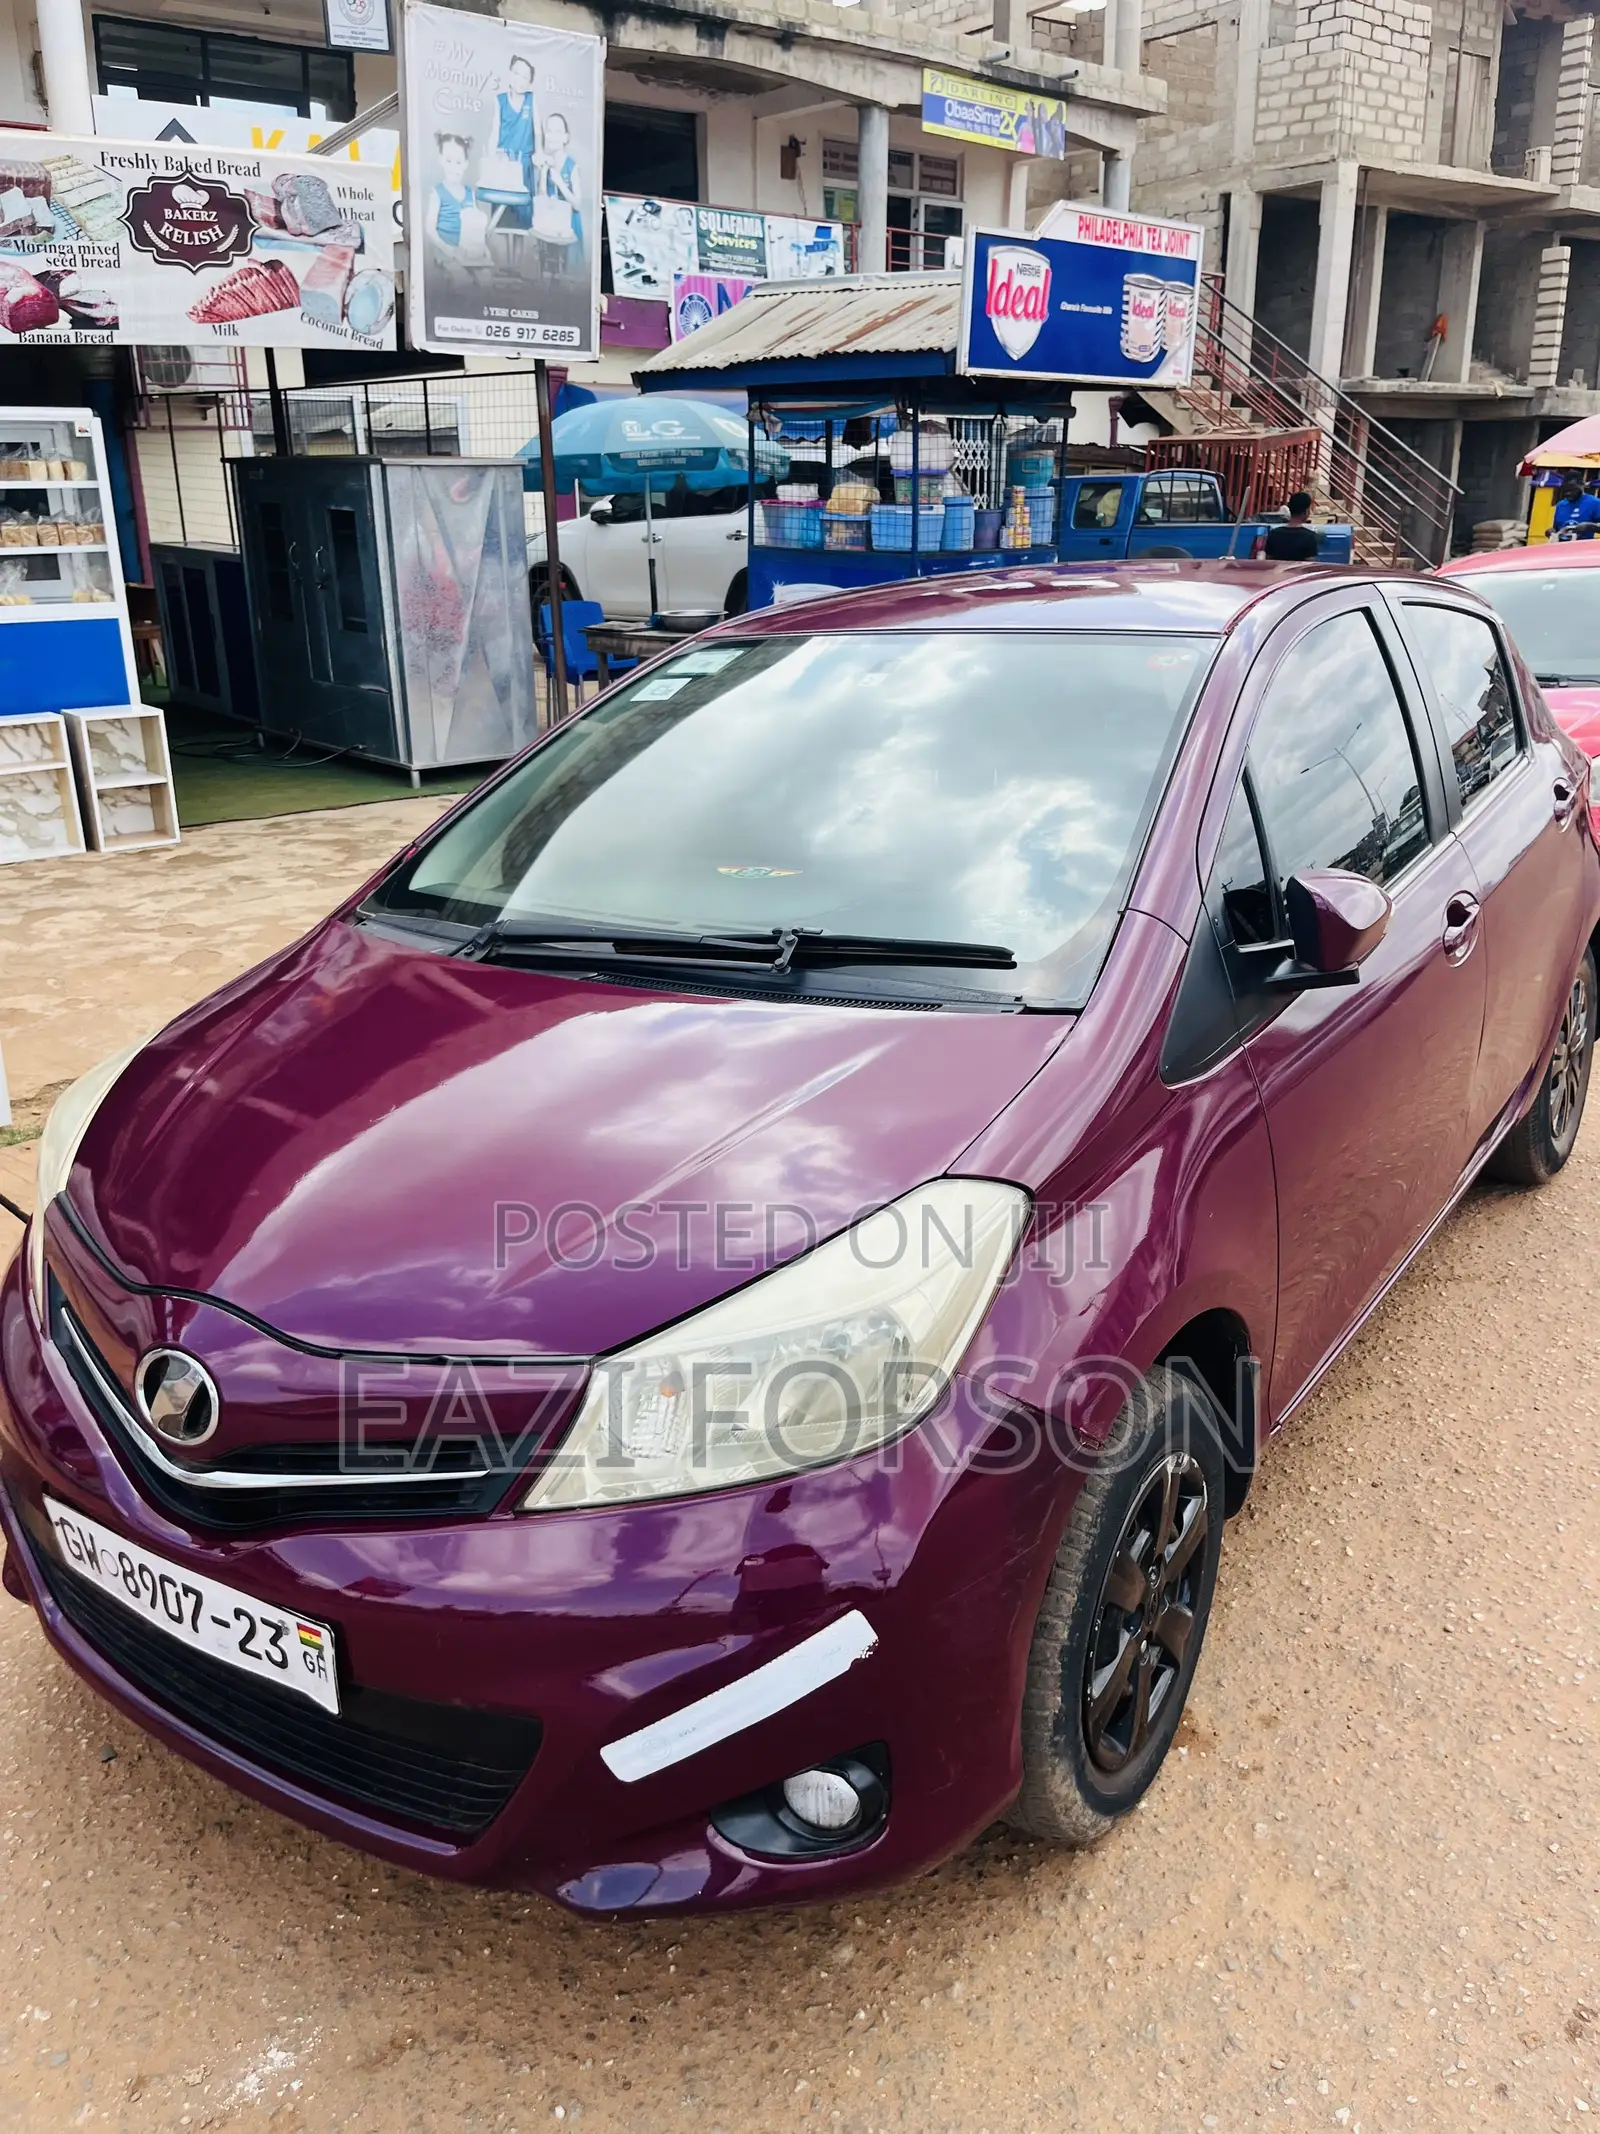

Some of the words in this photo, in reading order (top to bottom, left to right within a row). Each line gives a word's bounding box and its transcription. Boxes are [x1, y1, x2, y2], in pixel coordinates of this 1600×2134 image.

[433, 87, 484, 115] Cake
[100, 150, 160, 175] Freshly
[164, 156, 213, 175] Baked
[217, 159, 262, 178] Bread
[336, 186, 375, 201] Whole
[163, 207, 219, 223] BAKERZ
[338, 207, 376, 222] Wheat
[159, 222, 226, 247] RELISH
[704, 231, 758, 250] Services
[1077, 215, 1144, 249] PHILADELPHIA
[1147, 227, 1162, 250] TEA
[1164, 231, 1191, 257] JOINT
[13, 239, 74, 258] Moringa
[78, 242, 120, 256] mixed
[45, 253, 77, 268] seed
[81, 254, 121, 269] bread
[985, 258, 1053, 321] Ideal
[19, 330, 71, 344] Banana
[75, 331, 114, 344] Bread
[211, 322, 239, 337] Milk
[300, 311, 348, 339] Coconut
[351, 328, 384, 350] Bread
[485, 325, 511, 337] 026
[516, 327, 537, 340] 917
[542, 329, 575, 342] 6285
